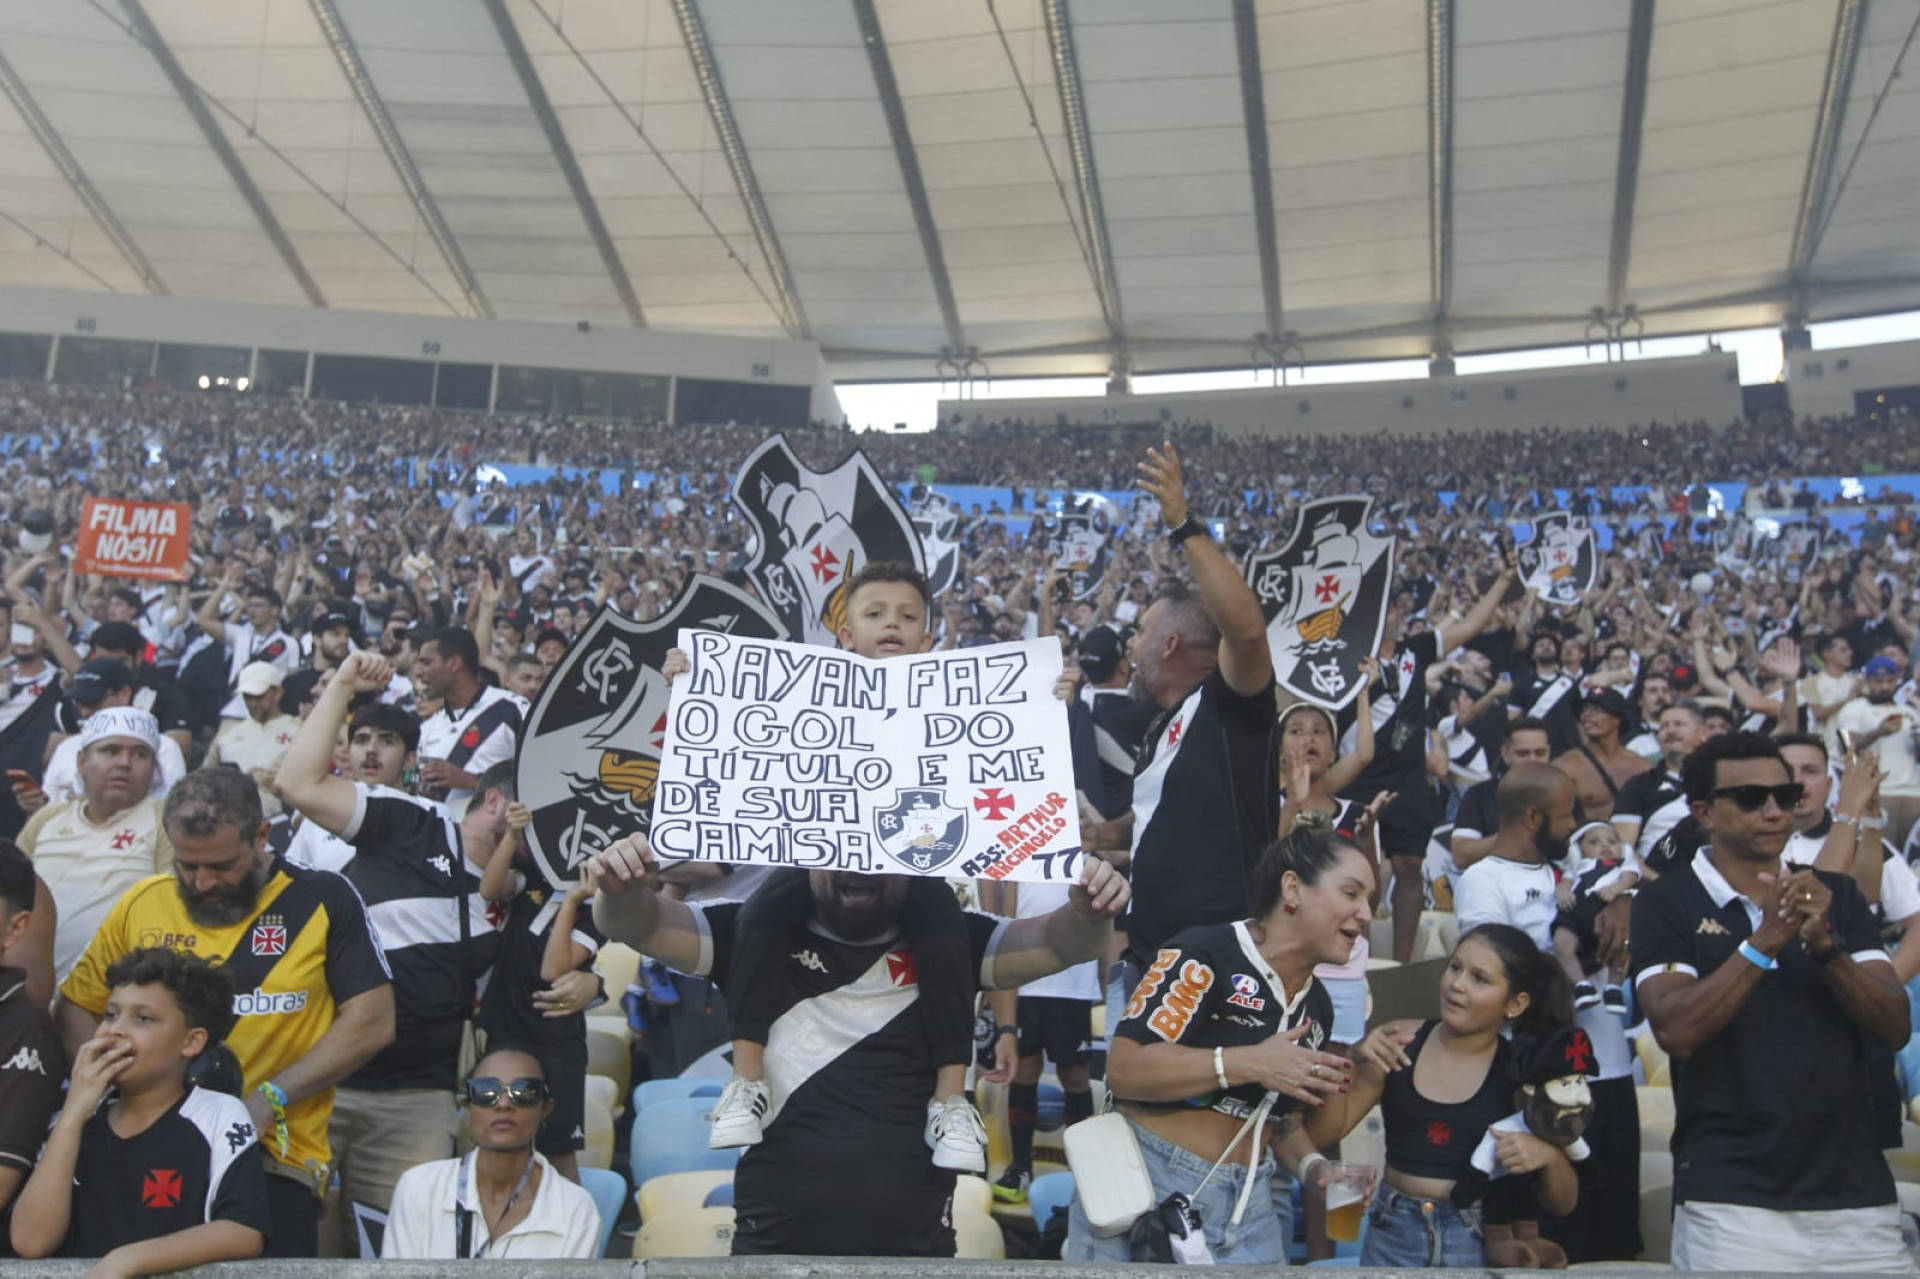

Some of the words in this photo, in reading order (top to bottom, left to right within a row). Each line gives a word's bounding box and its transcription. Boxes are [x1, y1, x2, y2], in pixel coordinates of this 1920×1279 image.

[89, 503, 176, 536] FILMA
[688, 631, 898, 722] RAYAN,
[908, 651, 1028, 708] FAZ
[676, 699, 719, 745] O
[733, 704, 875, 752] GOL
[924, 711, 1014, 748] DO
[673, 746, 893, 791] TÍTULO
[917, 754, 948, 787] E
[968, 746, 1045, 784] ME
[661, 777, 721, 817] DÊ
[735, 787, 860, 824] SUA
[960, 843, 1006, 877] ASS:
[996, 792, 1068, 850] ARTHUR
[984, 817, 1066, 880] ARCANGELO
[1032, 846, 1082, 879] 77
[1147, 960, 1215, 1042] BMG
[1227, 993, 1266, 1011] ALE
